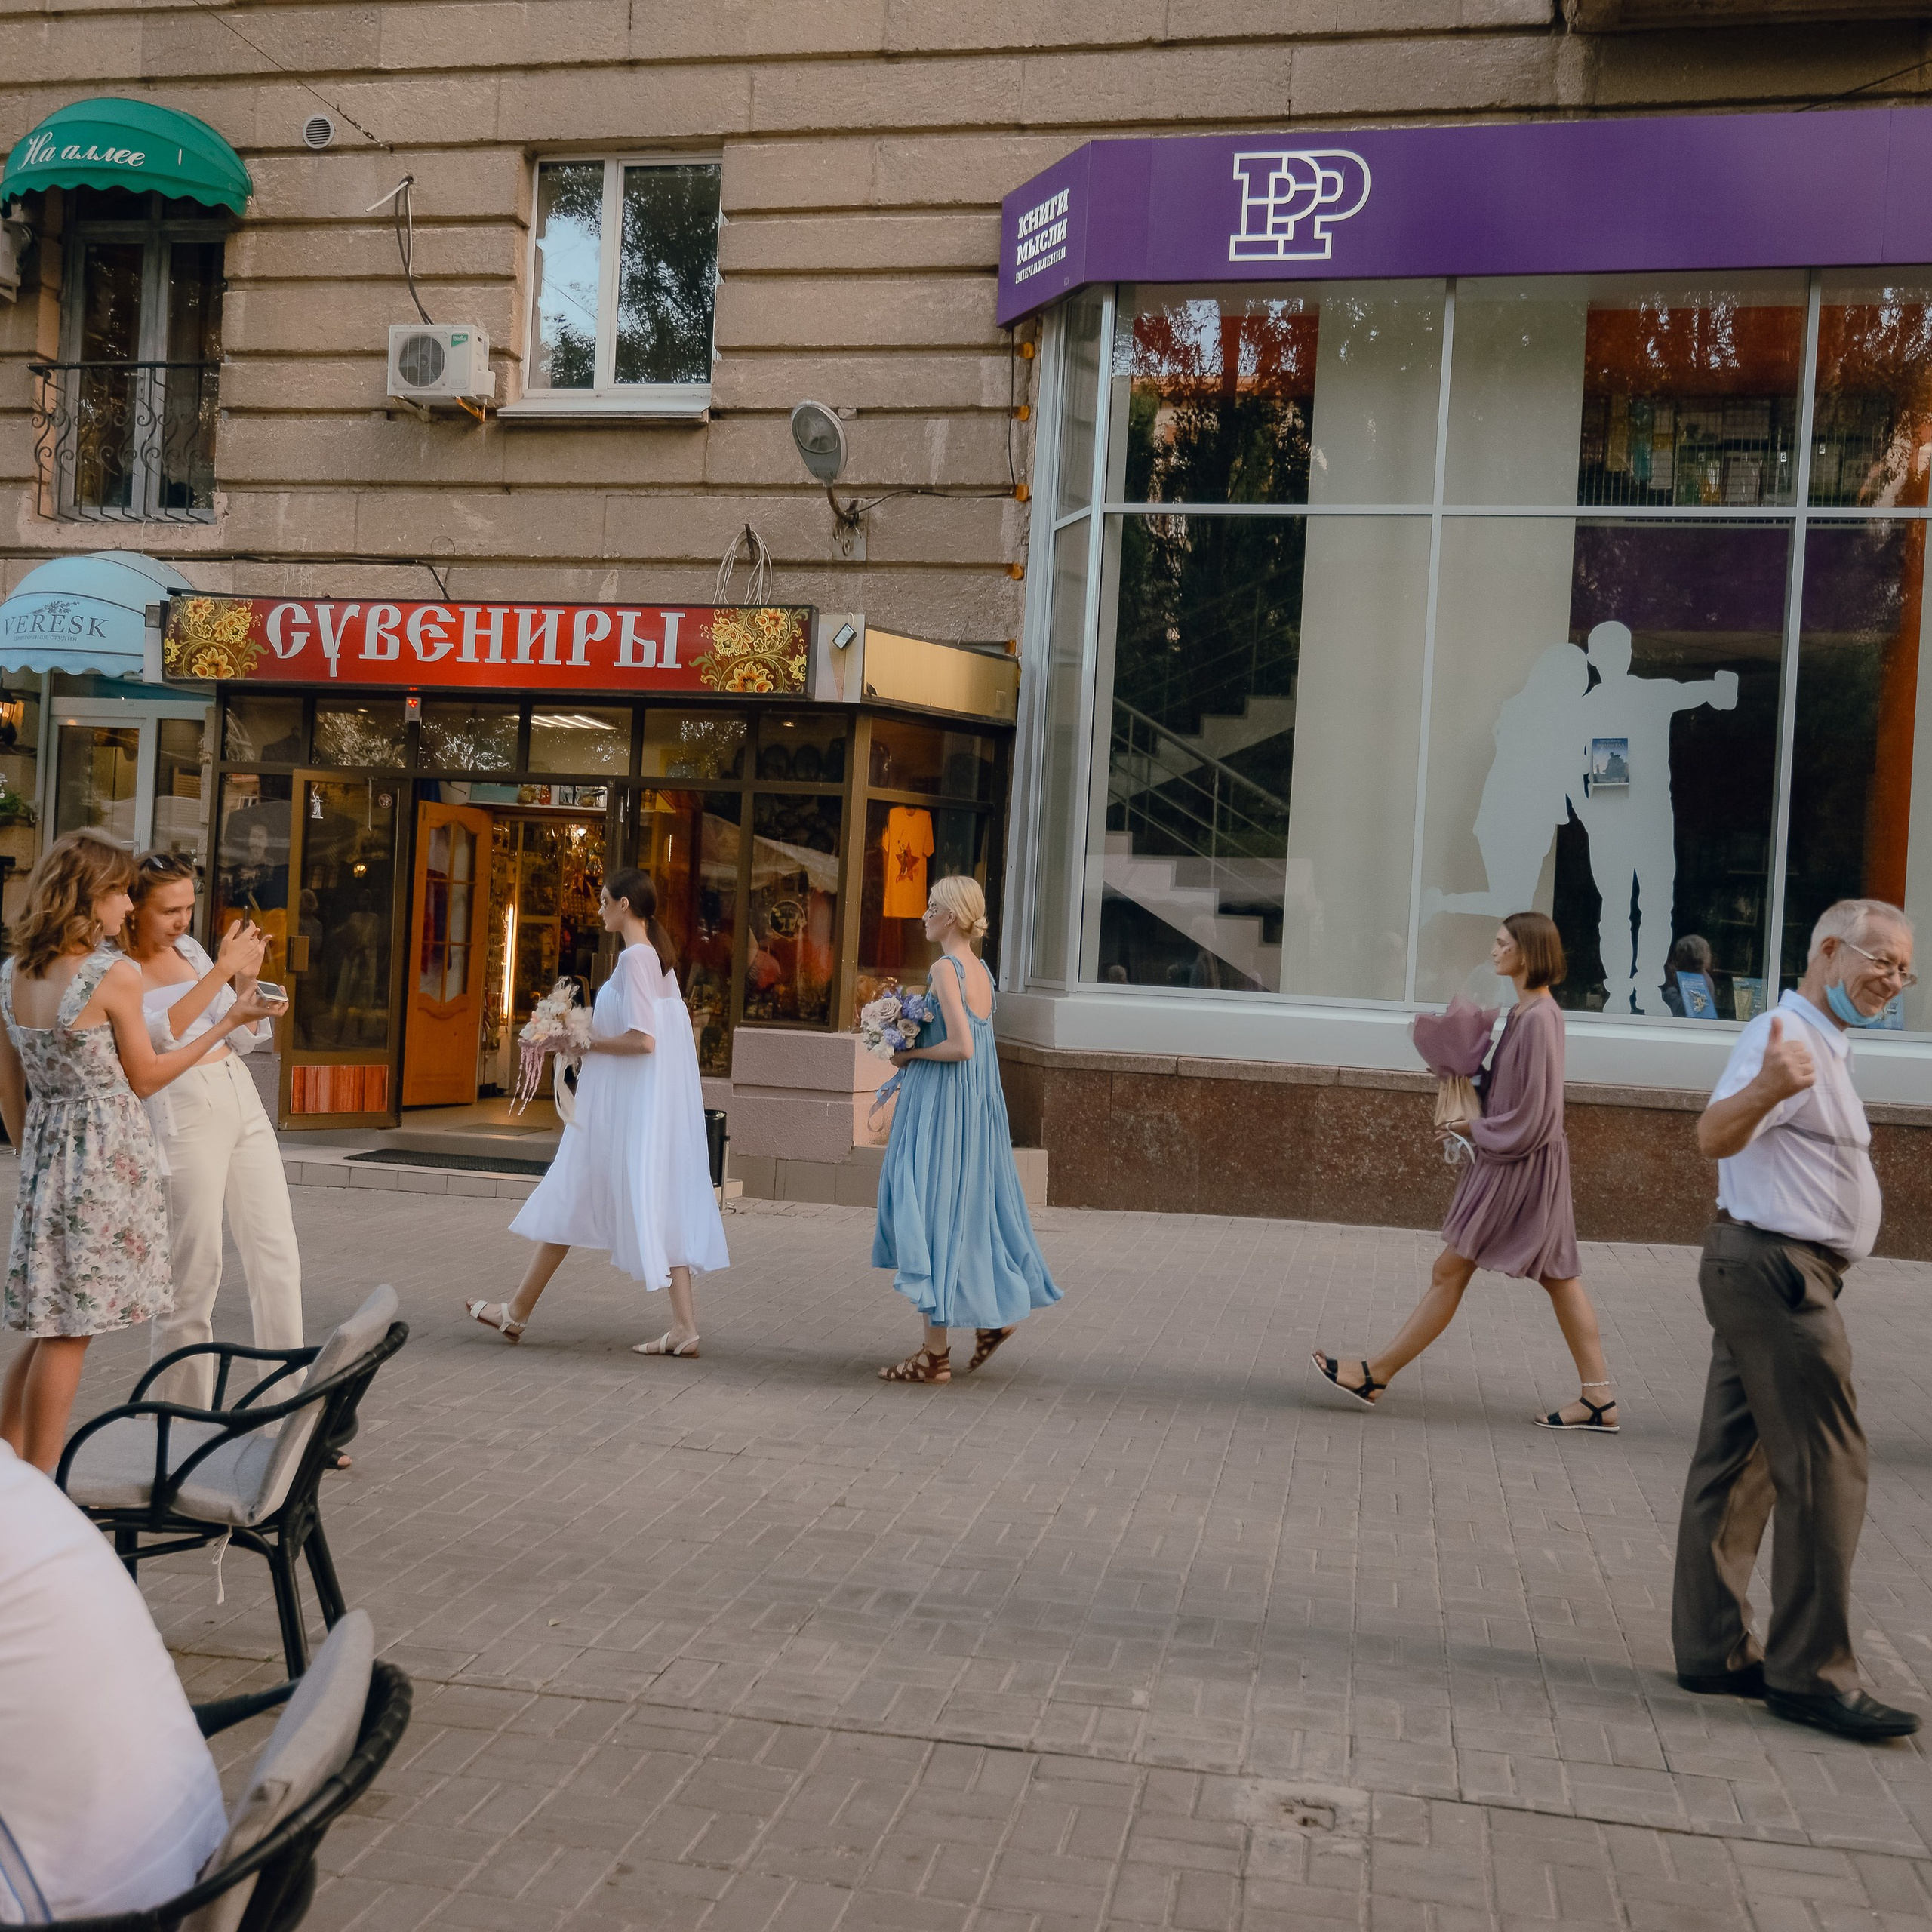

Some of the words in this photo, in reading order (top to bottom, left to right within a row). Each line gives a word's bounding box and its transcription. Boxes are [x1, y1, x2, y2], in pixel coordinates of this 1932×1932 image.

[17, 131, 57, 170] На
[61, 145, 146, 167] аллее
[1017, 188, 1069, 240] КНИГИ
[1016, 217, 1068, 266] МЫСЛИ
[1015, 246, 1066, 285] ВПЕЧАТЛЕНИЯ
[5, 614, 109, 638] VERESK
[266, 603, 685, 678] СУВЕНИРЫ
